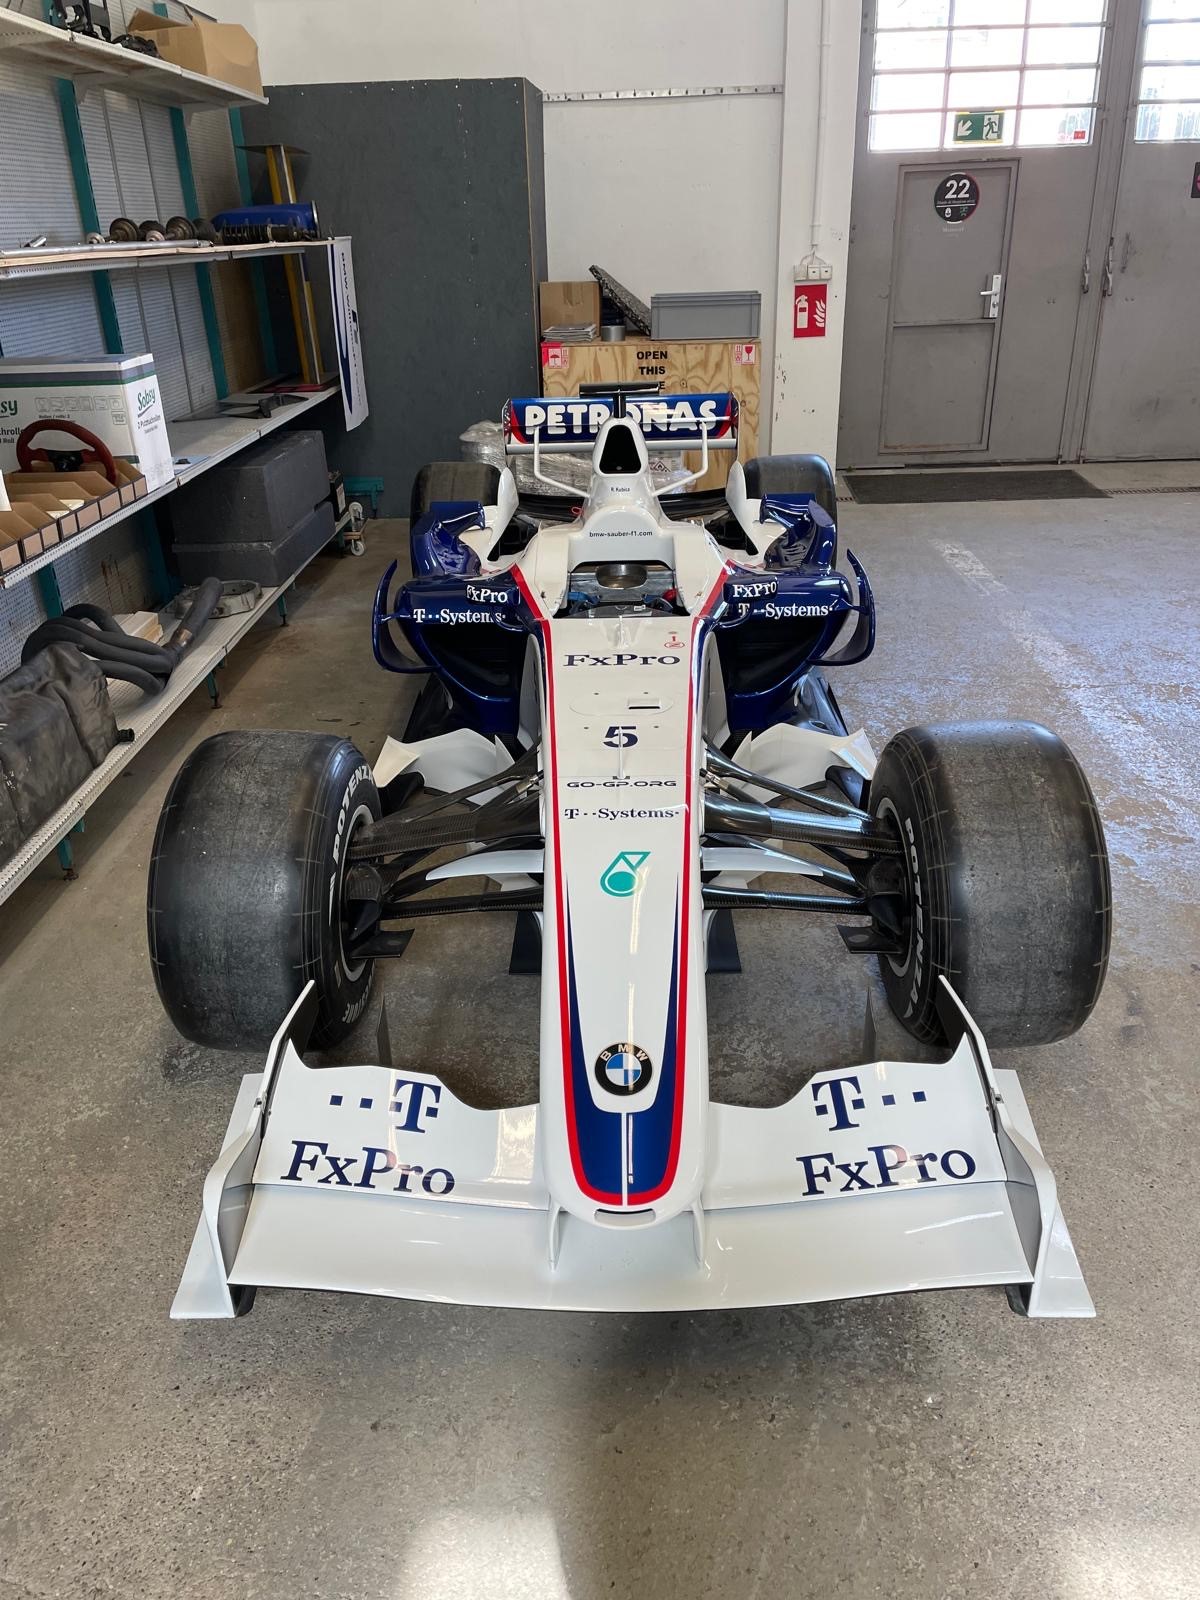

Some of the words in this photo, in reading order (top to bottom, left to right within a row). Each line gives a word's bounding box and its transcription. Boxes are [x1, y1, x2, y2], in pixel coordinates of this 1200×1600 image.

[945, 179, 970, 199] 22
[636, 351, 668, 360] OPEN
[638, 366, 666, 376] THIS
[589, 530, 653, 538] bmw-sauber-f1.com
[466, 584, 508, 603] FxPro
[732, 581, 777, 598] FxPro
[563, 653, 681, 666] FxPro
[602, 726, 639, 748] 5
[567, 780, 677, 788] GO-GP.ORG
[332, 763, 374, 865] POTENZA
[599, 1044, 649, 1061] BMW
[280, 1140, 455, 1195] FxPro
[796, 1144, 976, 1196] FxPro
